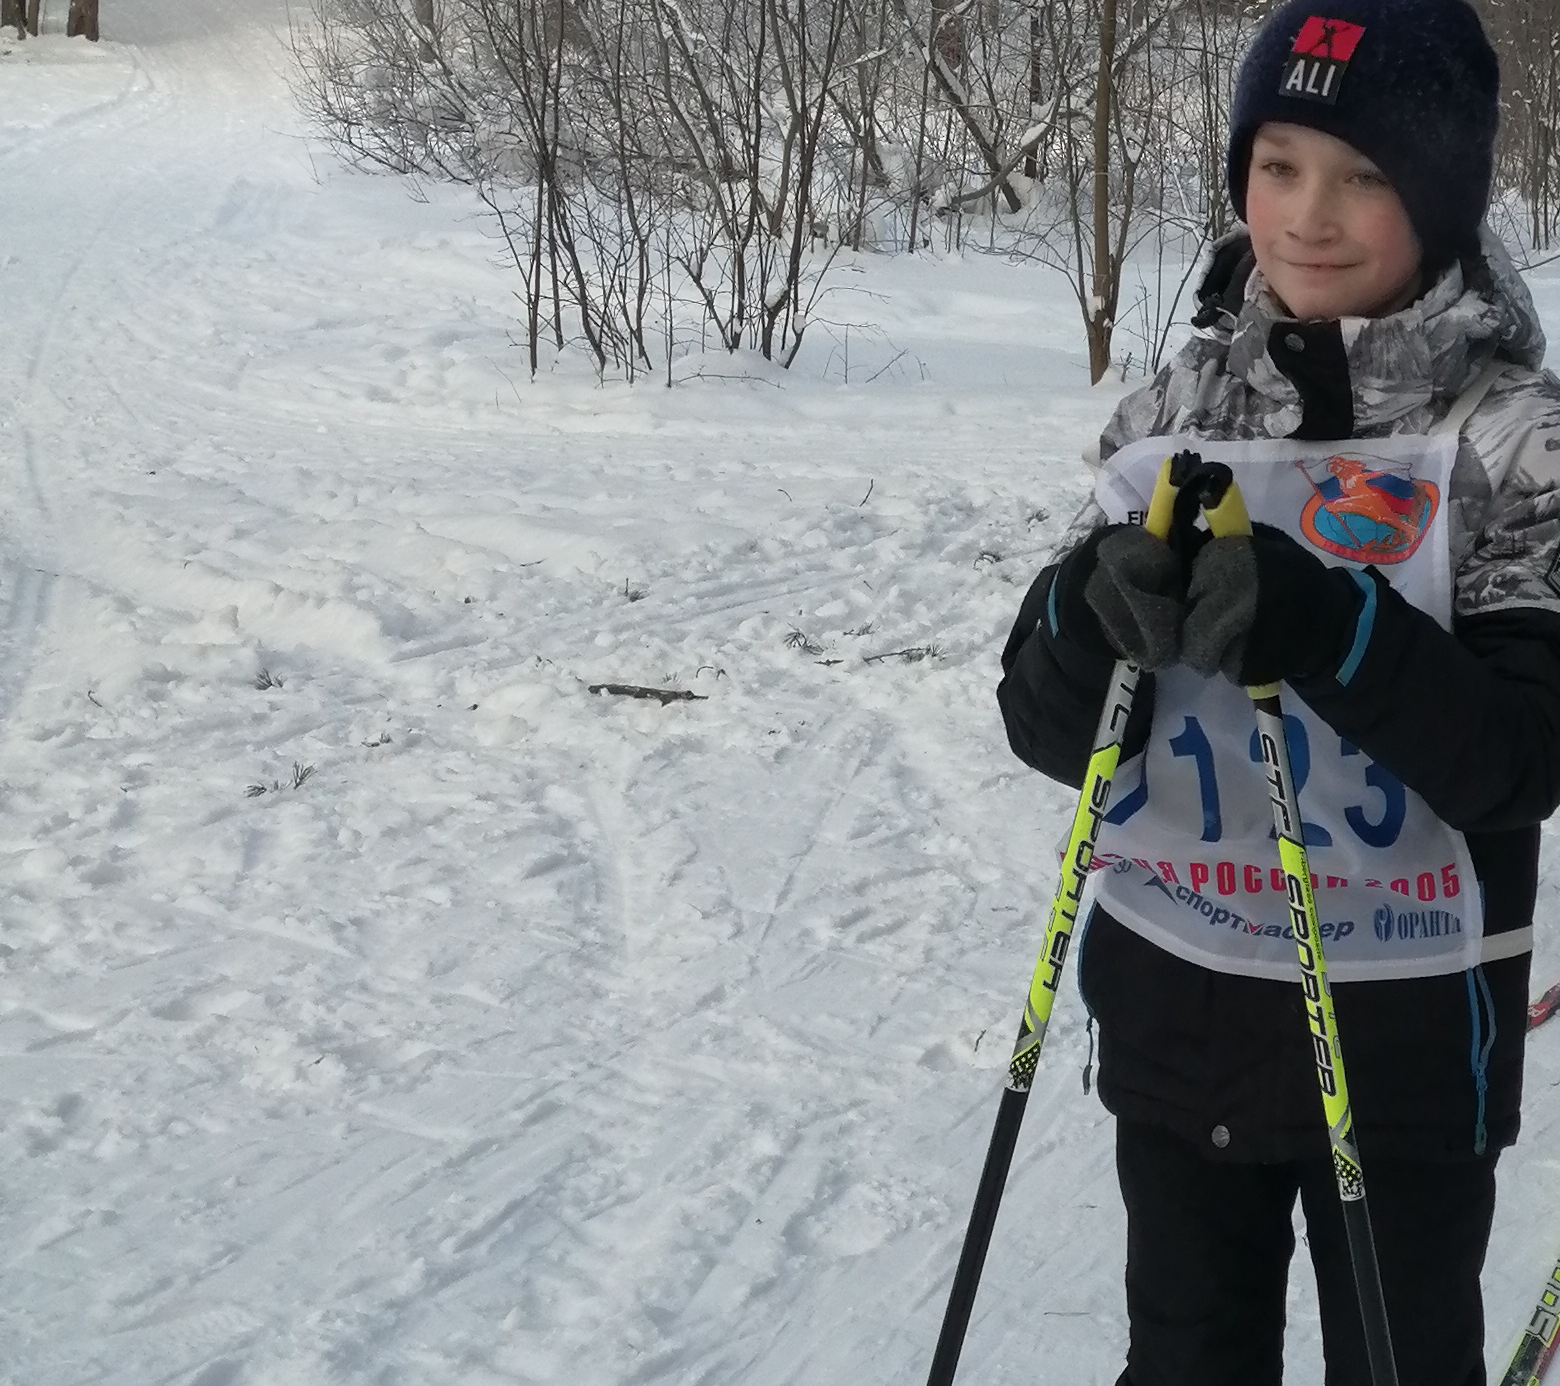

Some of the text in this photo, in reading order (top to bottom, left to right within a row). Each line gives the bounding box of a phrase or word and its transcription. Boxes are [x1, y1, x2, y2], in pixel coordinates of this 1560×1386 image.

[1285, 59, 1336, 97] ALI
[1176, 885, 1355, 944] спортмасер
[1287, 872, 1337, 1098] SPORTER
